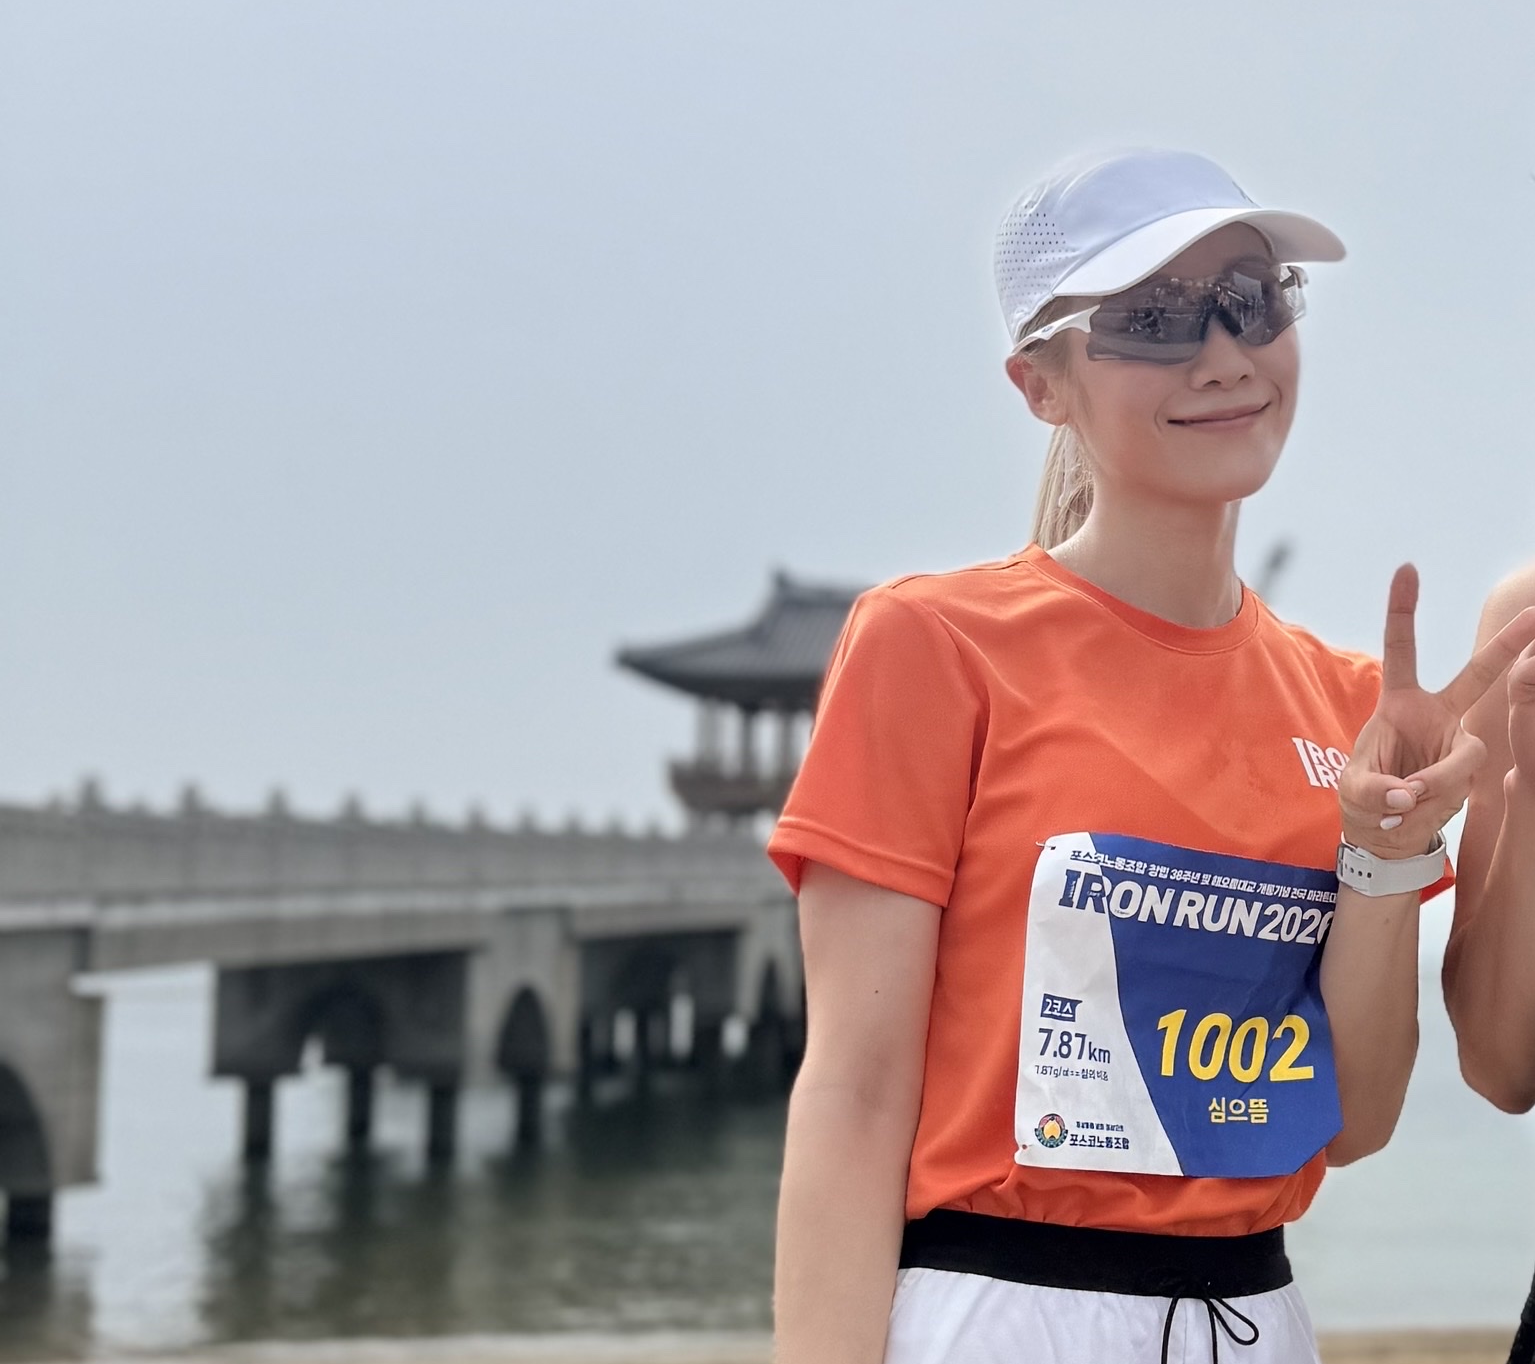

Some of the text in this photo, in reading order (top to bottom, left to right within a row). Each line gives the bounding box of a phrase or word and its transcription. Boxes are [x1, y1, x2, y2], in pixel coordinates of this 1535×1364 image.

[1170, 868, 1201, 884] 38주년
[1058, 869, 1176, 924] IRON
[1172, 890, 1263, 937] RUN
[1043, 999, 1074, 1018] 2코스
[1038, 1028, 1111, 1064] 7.87km
[1156, 1009, 1315, 1083] 1002
[1208, 1097, 1270, 1124] 심으뜸
[1069, 1134, 1130, 1150] 포스코노동조합
